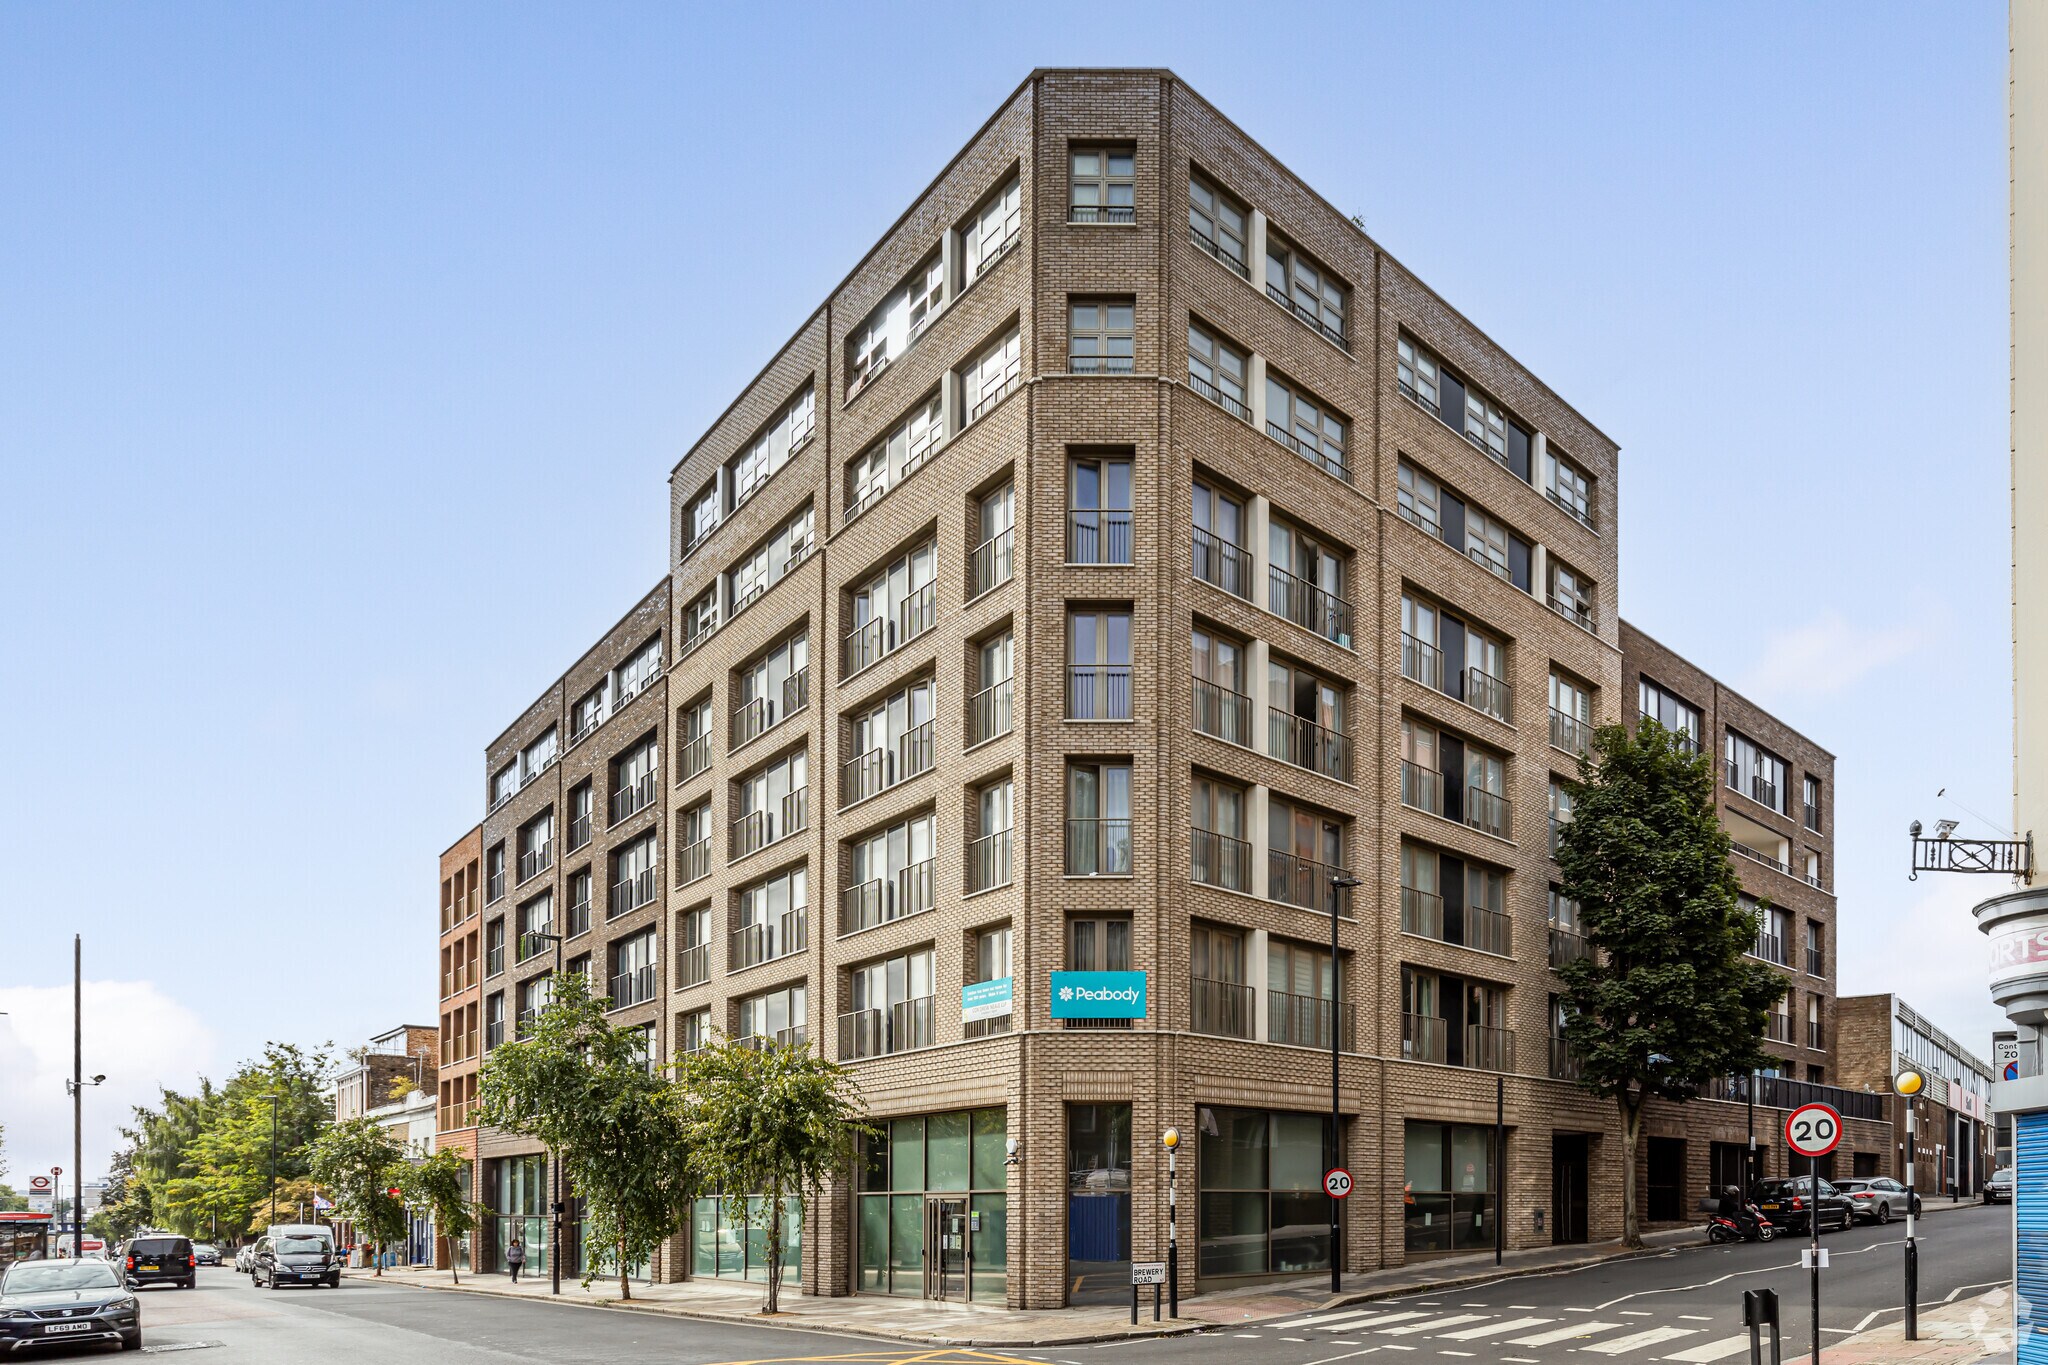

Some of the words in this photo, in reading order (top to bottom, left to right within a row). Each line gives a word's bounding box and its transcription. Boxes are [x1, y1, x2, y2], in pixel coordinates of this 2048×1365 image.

[1076, 986, 1140, 1005] Peabody
[2004, 1051, 2018, 1059] ZO
[1794, 1119, 1834, 1142] 20
[1329, 1177, 1350, 1190] 20
[1134, 1268, 1164, 1276] BREWERY
[1134, 1276, 1152, 1284] ROAD
